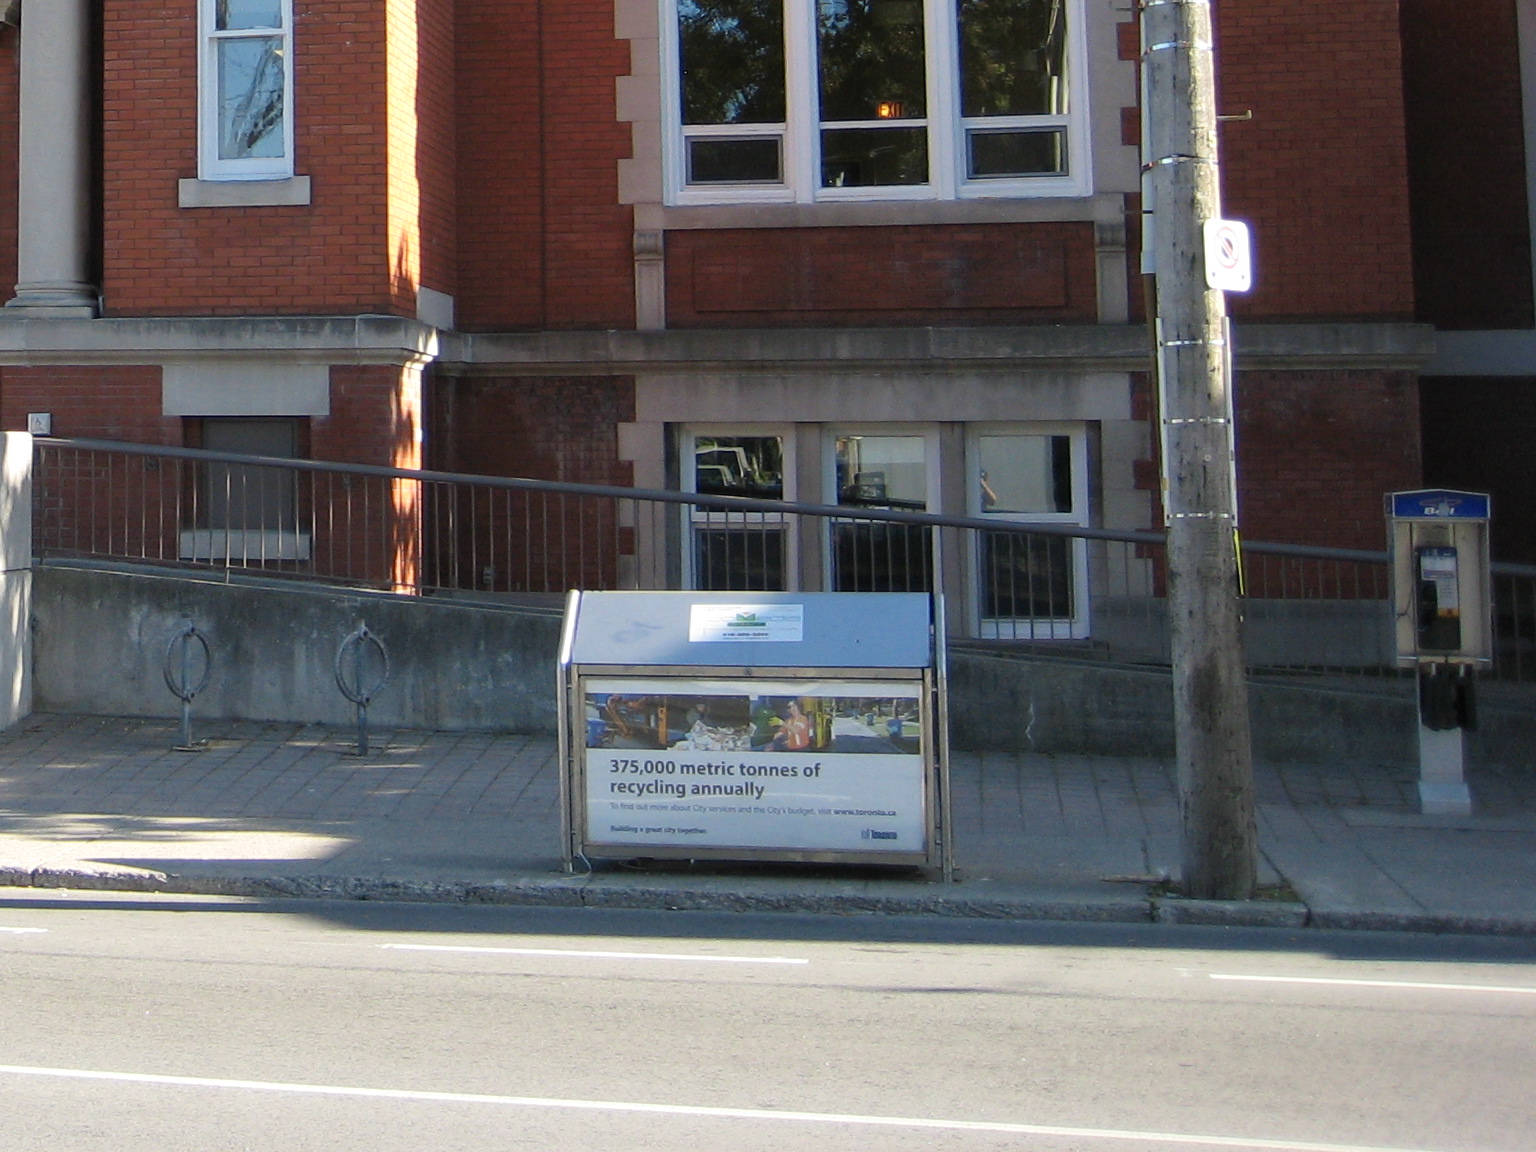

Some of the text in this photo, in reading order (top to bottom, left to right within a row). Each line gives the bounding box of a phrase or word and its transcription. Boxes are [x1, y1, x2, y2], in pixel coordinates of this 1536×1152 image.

[610, 759, 821, 778] 375,000 metric tonnes of
[610, 780, 765, 801] recycling annually
[610, 802, 619, 810] To
[670, 804, 691, 812] about
